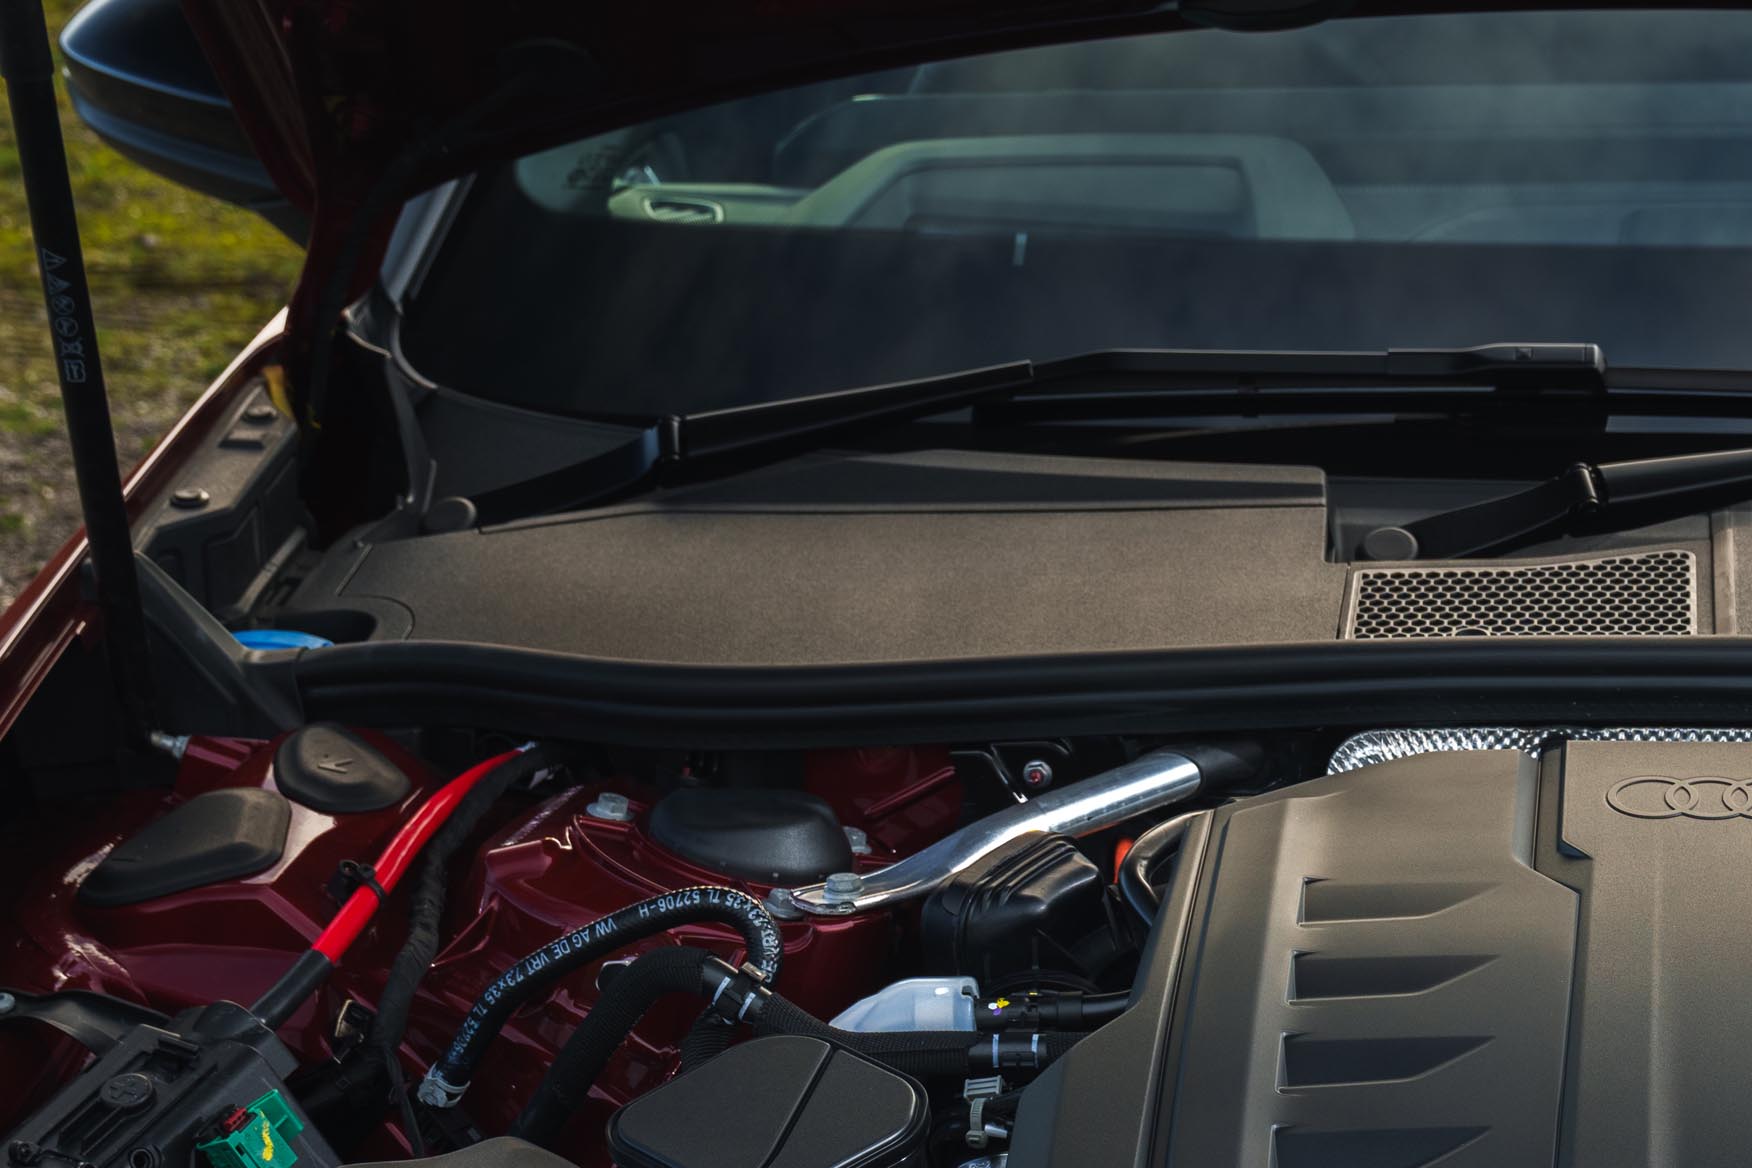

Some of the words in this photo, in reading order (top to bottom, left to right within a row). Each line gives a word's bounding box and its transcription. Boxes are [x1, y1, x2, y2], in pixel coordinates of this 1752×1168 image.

[638, 889, 700, 919] 52706-H
[707, 889, 720, 903] TL
[595, 917, 617, 937] VW
[572, 928, 590, 948] AG
[552, 940, 571, 959] DE
[525, 952, 551, 976] VRT
[472, 1003, 488, 1016] TL
